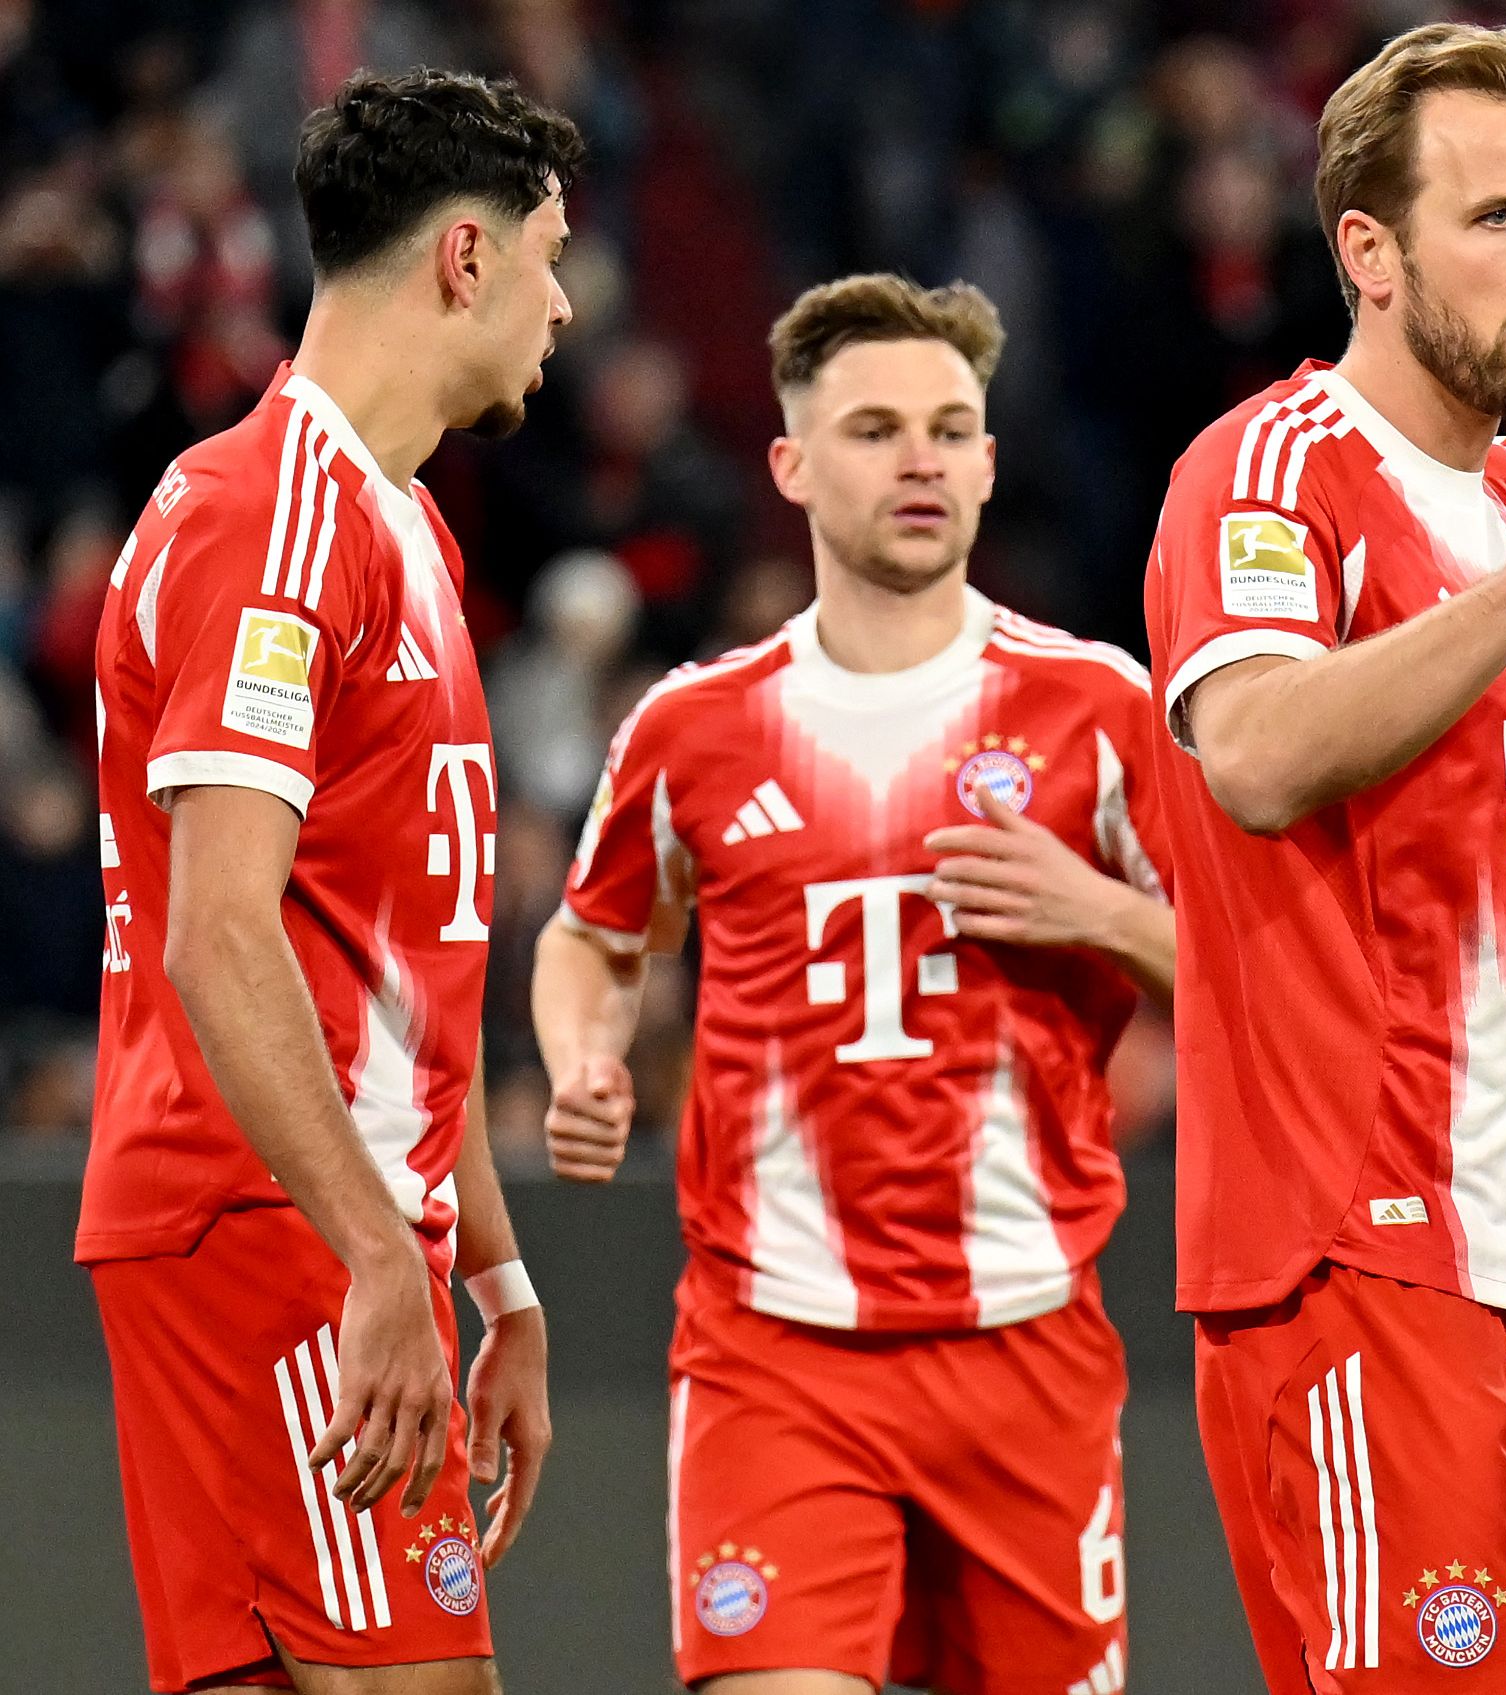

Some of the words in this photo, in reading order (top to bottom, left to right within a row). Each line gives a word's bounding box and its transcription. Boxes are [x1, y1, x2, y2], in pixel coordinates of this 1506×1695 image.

[1230, 575, 1307, 588] BUNDESLIGA
[236, 679, 310, 704] BUNDESLIGA
[230, 710, 305, 733] FUSSBALLMEISTER
[245, 705, 293, 721] DEUTSCHER
[245, 721, 287, 736] 2024/2025
[427, 743, 496, 943] T
[804, 873, 959, 1063] T
[429, 1556, 442, 1574] FC
[438, 1543, 476, 1570] BAYERN
[1079, 1484, 1126, 1624] 6
[1424, 1603, 1440, 1622] FC
[1439, 1592, 1491, 1621] BAYERN
[1425, 1634, 1491, 1662] MÜNCHEN
